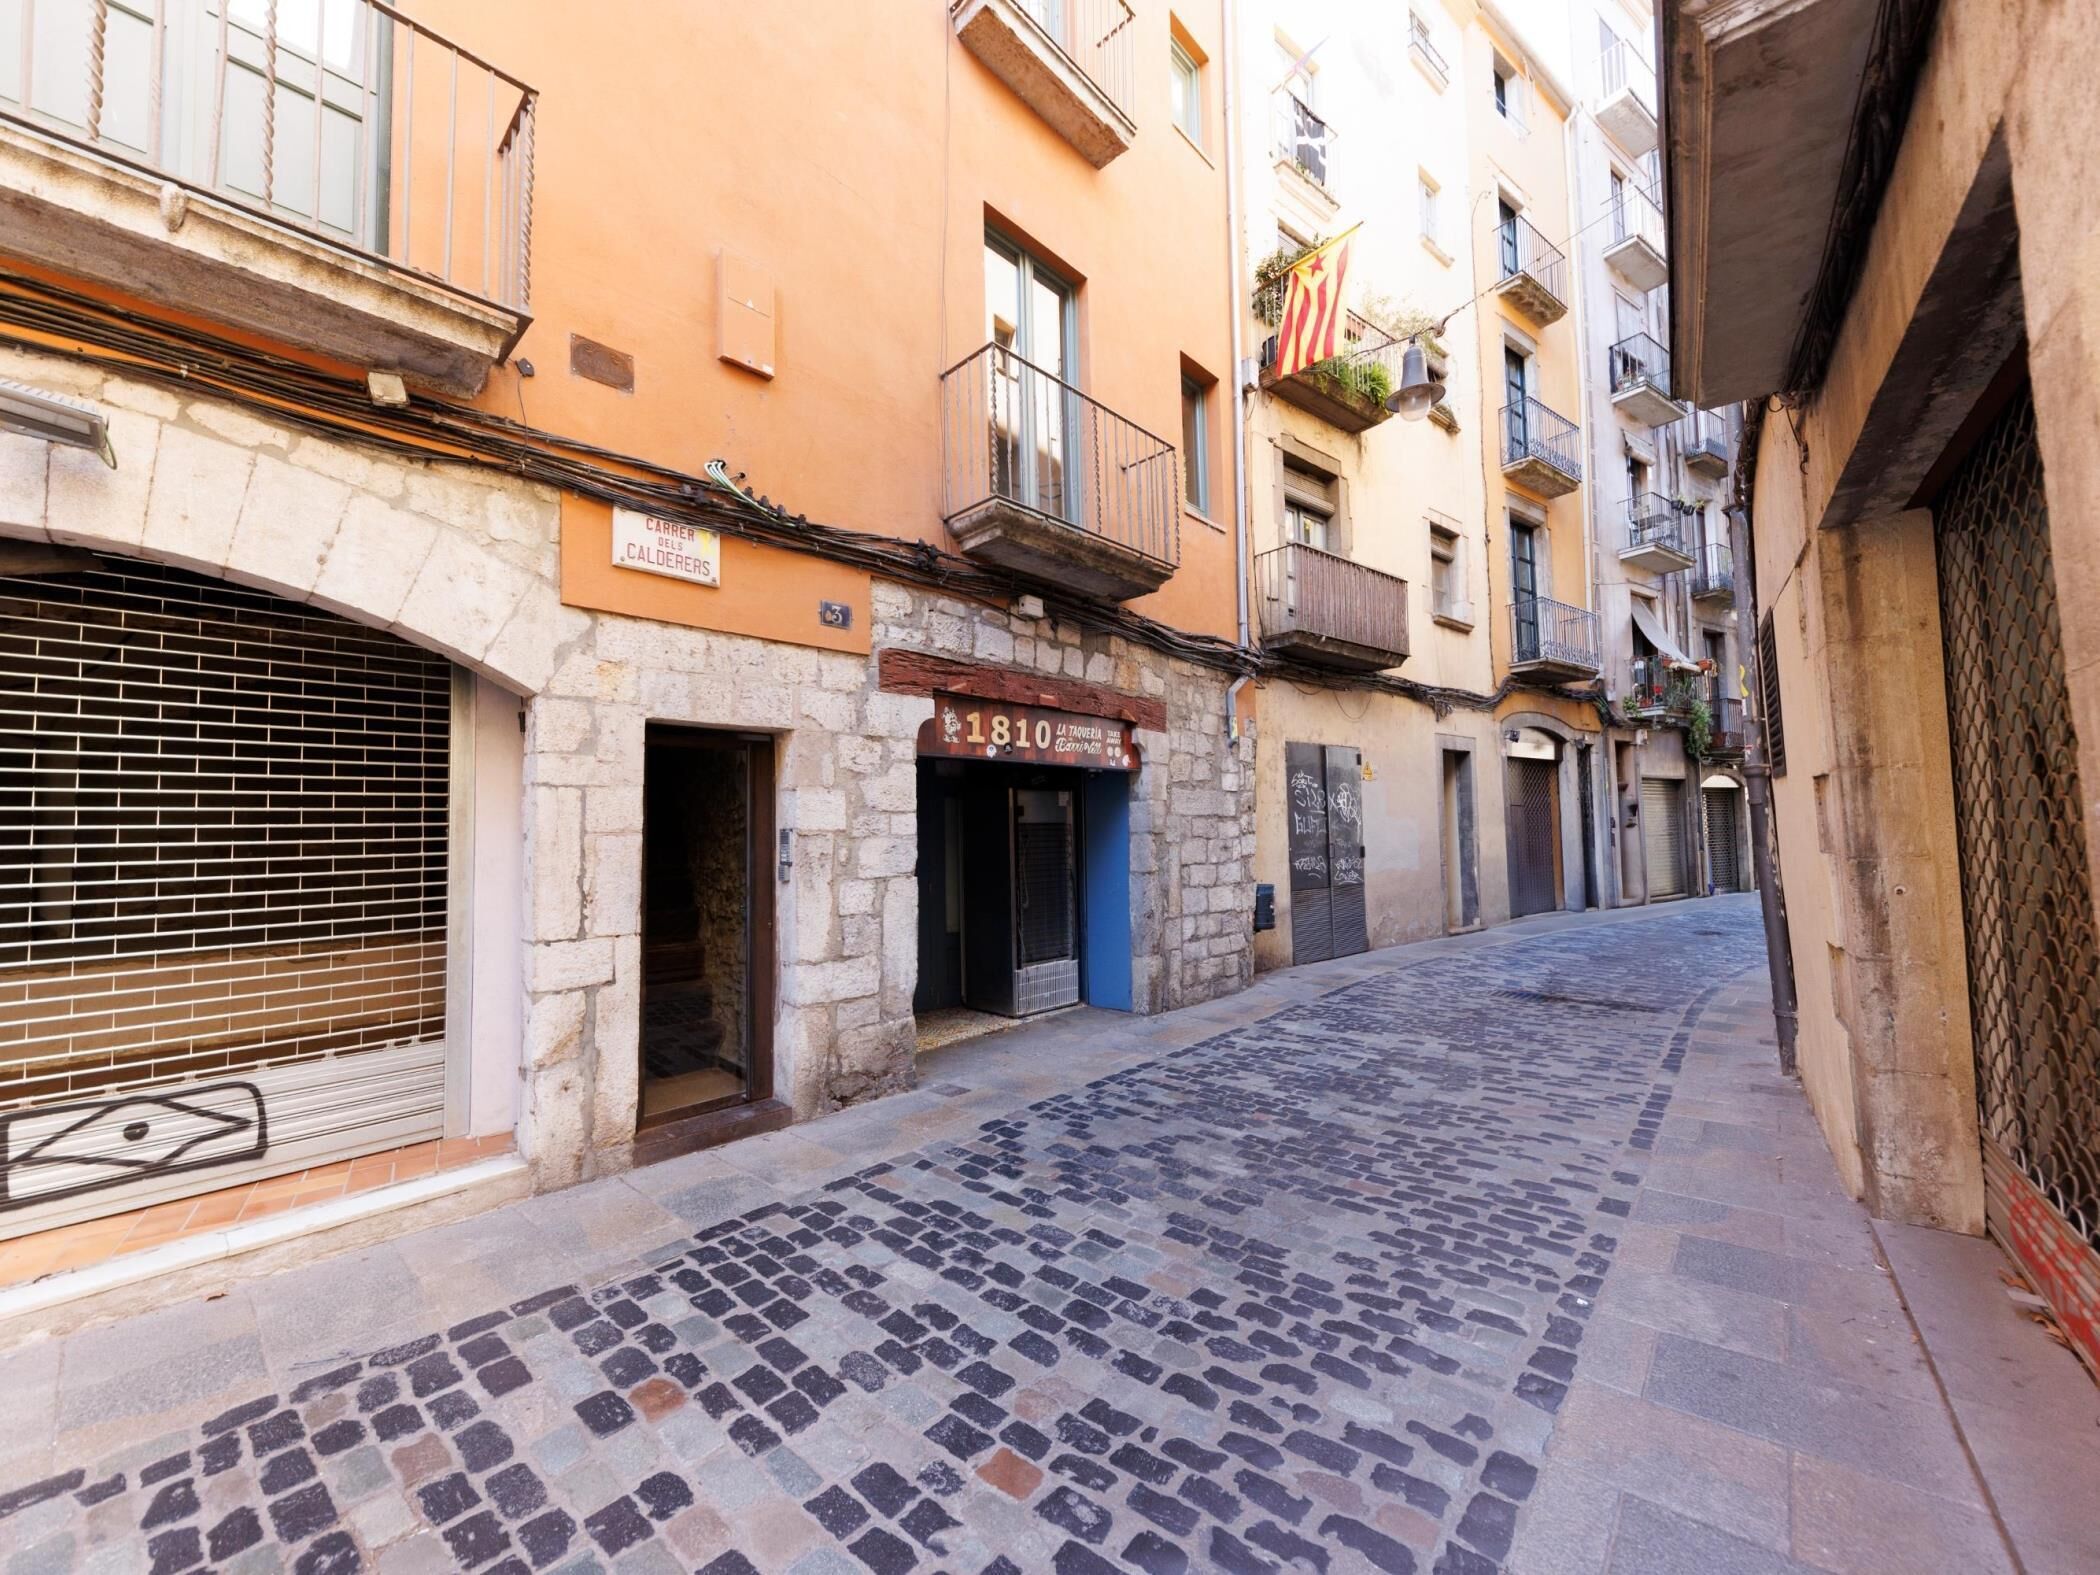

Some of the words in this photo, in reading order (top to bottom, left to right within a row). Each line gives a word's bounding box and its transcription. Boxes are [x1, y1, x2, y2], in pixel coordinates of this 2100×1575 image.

[646, 517, 695, 542] CARRER
[658, 536, 683, 551] DELS
[627, 542, 711, 577] CALDERERS
[831, 604, 843, 624] 3
[966, 711, 1052, 750] 1810
[1055, 723, 1067, 736] LA
[1107, 729, 1121, 738] TAKE
[1105, 737, 1122, 745] AWAY
